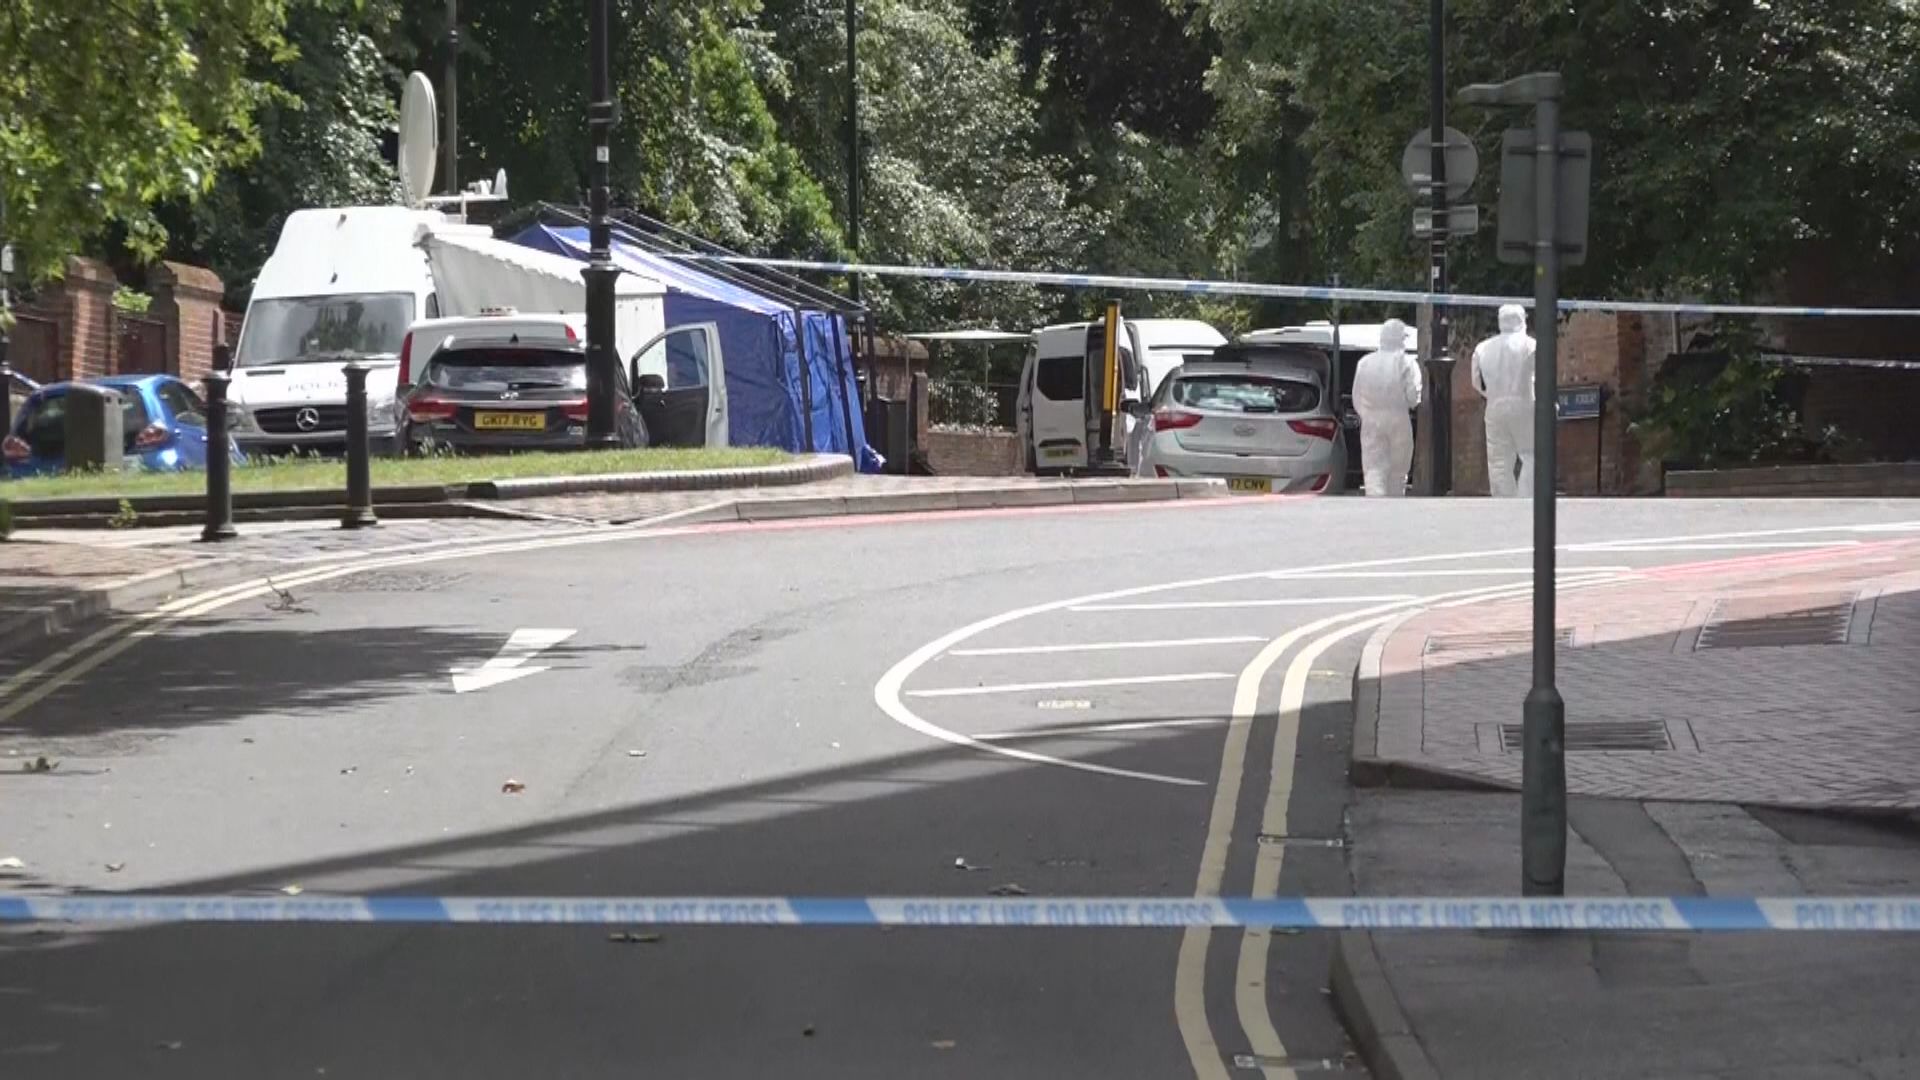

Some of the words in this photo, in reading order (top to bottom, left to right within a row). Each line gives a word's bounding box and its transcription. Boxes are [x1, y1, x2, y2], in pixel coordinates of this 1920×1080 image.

[482, 413, 510, 426] GK17
[512, 413, 538, 427] RYG
[1243, 478, 1266, 490] CNV
[476, 903, 552, 923] POLICE
[561, 903, 608, 923] LINE
[615, 903, 645, 923] DO
[655, 903, 697, 923] NOT
[706, 903, 778, 923] CROSS
[903, 903, 980, 925] POLICE
[988, 903, 1037, 925] LINE
[1046, 903, 1077, 925] DO
[1086, 903, 1130, 925] NOT
[1138, 903, 1213, 925] CROSS
[1341, 903, 1421, 927] POLICE
[1430, 903, 1479, 927] LINE
[1490, 903, 1521, 927] DO
[1531, 903, 1577, 927] NOT
[1585, 903, 1665, 927] CROSS
[1795, 904, 1876, 928] POLICE
[1886, 904, 1920, 928] LIN
